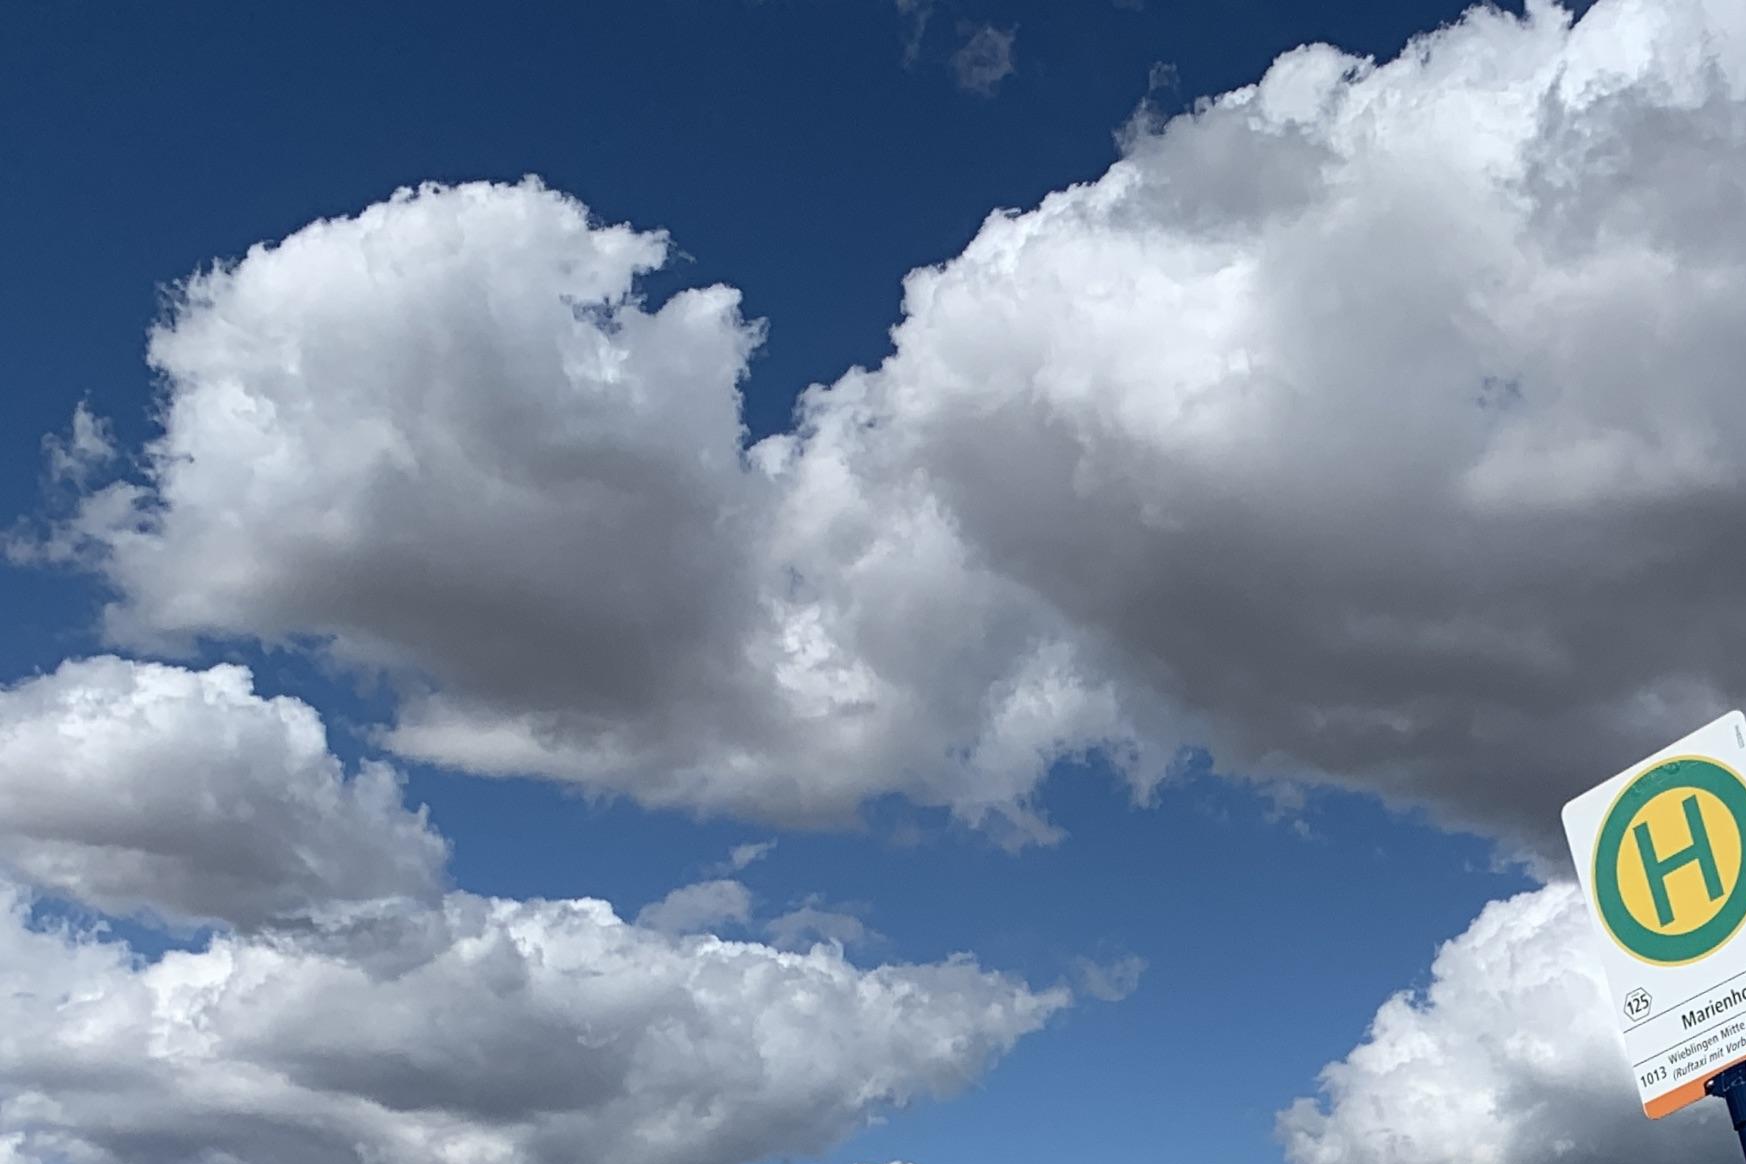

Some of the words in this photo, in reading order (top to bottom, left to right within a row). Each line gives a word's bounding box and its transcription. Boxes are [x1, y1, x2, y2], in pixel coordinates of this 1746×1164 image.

[1633, 794, 1724, 927] H
[1627, 994, 1649, 1015] 125
[1668, 1034, 1719, 1065] Wieblingen
[1720, 1020, 1745, 1040] Mitte
[1640, 1066, 1667, 1088] 1013
[1673, 1057, 1708, 1081] (Ruftaxi
[1709, 1047, 1725, 1063] mit
